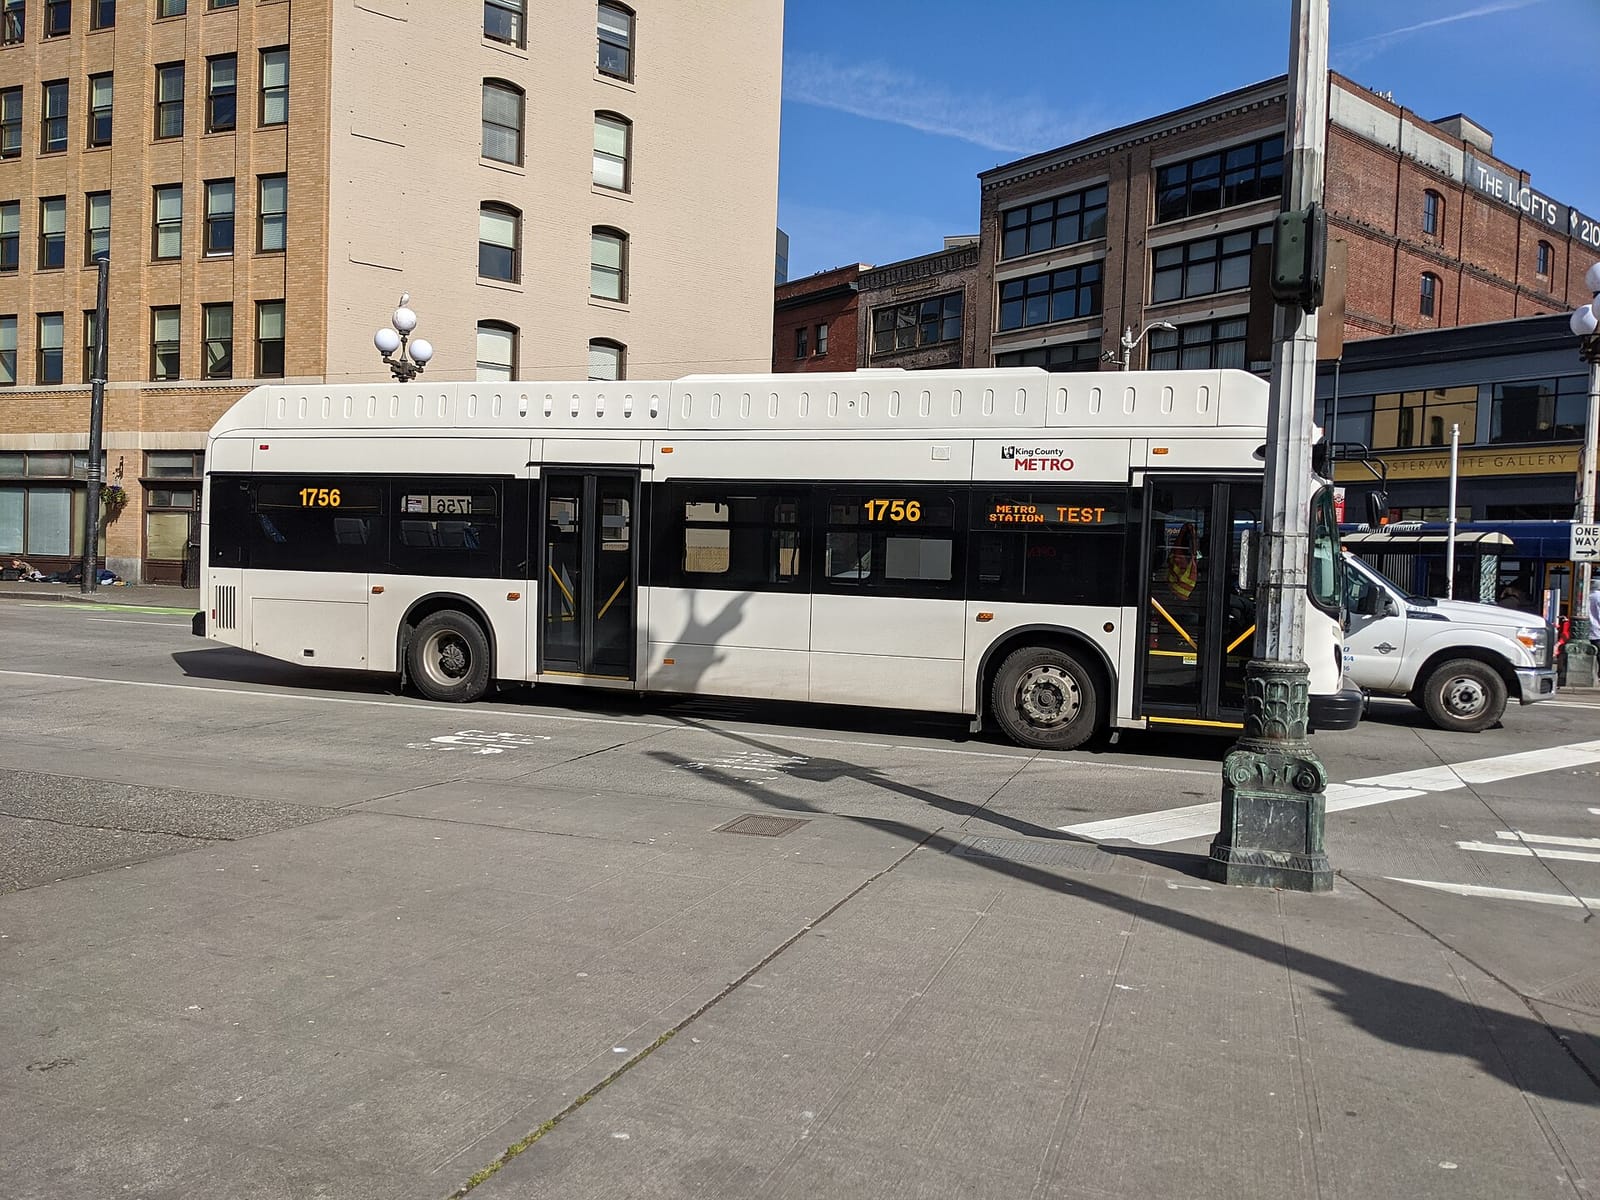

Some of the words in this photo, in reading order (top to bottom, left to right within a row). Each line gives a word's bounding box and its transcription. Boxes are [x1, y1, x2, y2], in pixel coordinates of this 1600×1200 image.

[1477, 166, 1503, 198] THE
[1508, 182, 1557, 225] LOFTS
[1015, 447, 1034, 457] King
[1034, 447, 1064, 457] County
[1014, 458, 1075, 471] METRO
[1494, 454, 1567, 468] GALLERY
[299, 488, 341, 507] 1756
[864, 499, 921, 522] 1756
[996, 505, 1036, 514] METRO
[1056, 506, 1105, 523] TEST
[989, 513, 1045, 523] STATION
[1575, 527, 1599, 536] ONE
[1574, 536, 1599, 546] WAY
